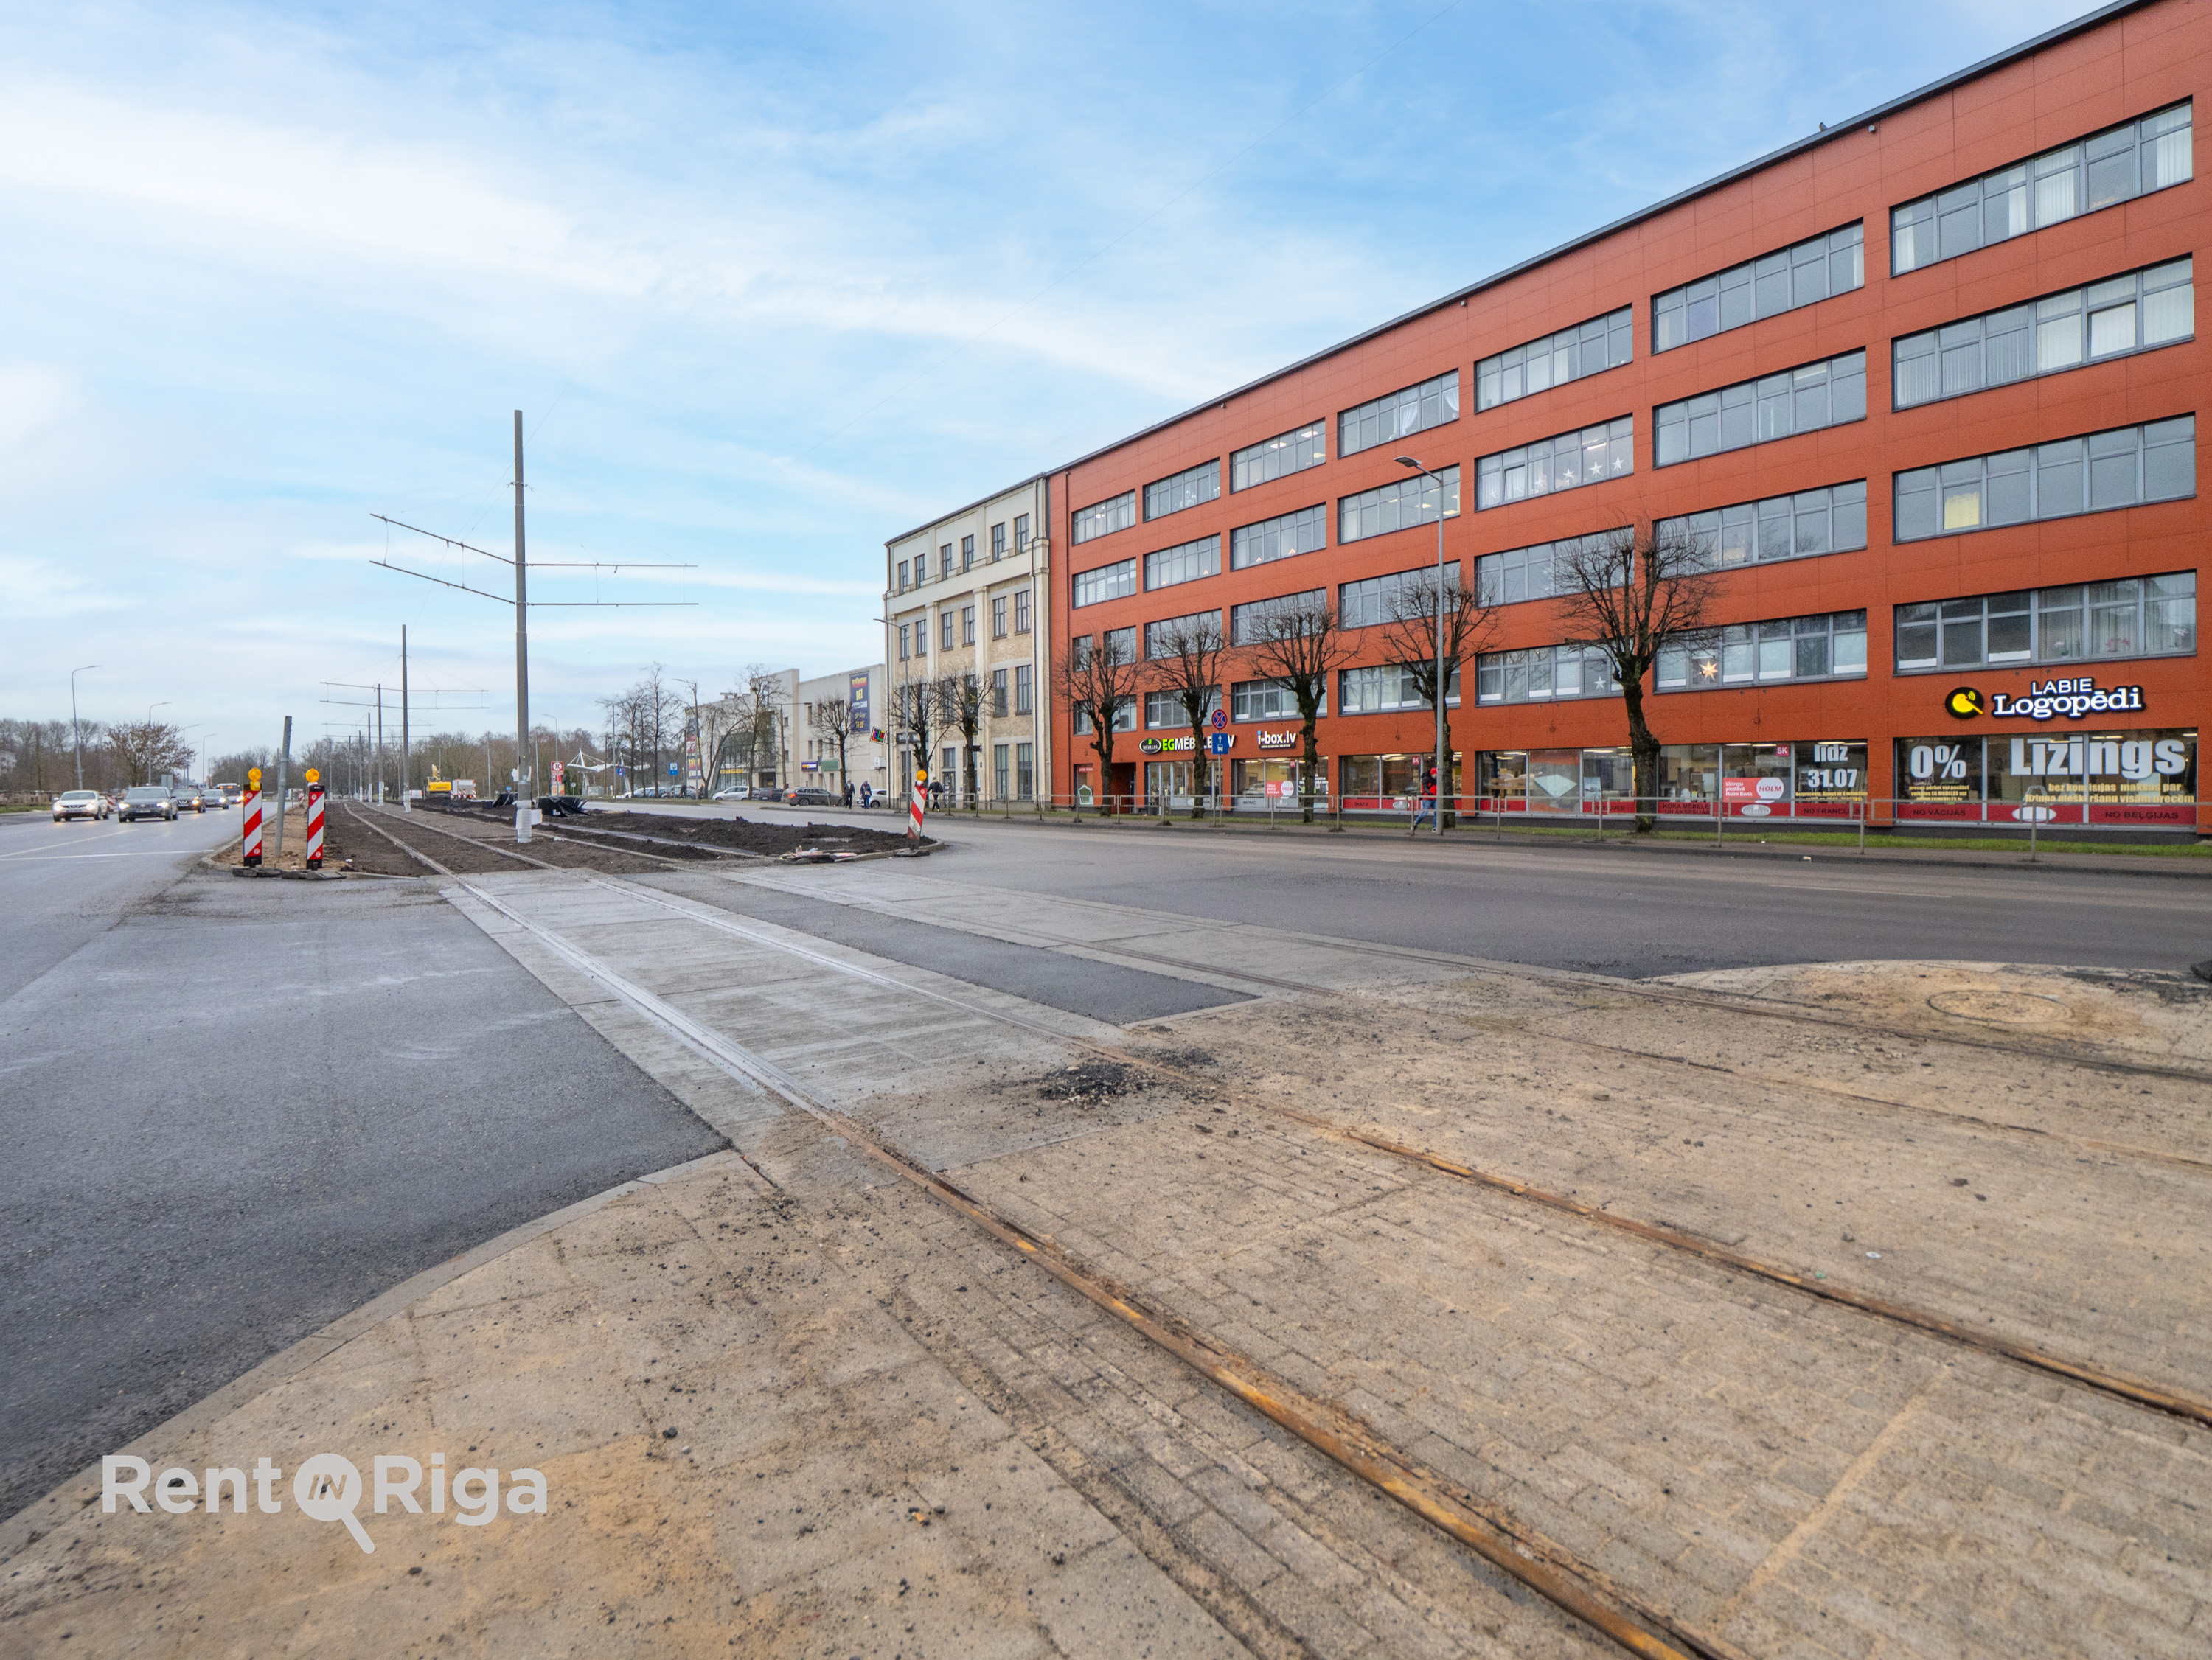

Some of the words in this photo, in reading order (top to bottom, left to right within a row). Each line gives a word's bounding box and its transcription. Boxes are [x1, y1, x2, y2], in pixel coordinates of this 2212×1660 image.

[2032, 678, 2093, 695] LABIE
[1994, 687, 2143, 719] Logopēdi
[1162, 734, 1235, 750] EGMĒBEV
[1257, 730, 1296, 744] i-box.lv
[1910, 744, 1966, 778] 0%
[2011, 736, 2185, 779] Līzings
[1808, 768, 1857, 788] 31.07
[2048, 783, 2065, 792] bez
[2163, 783, 2182, 792] par
